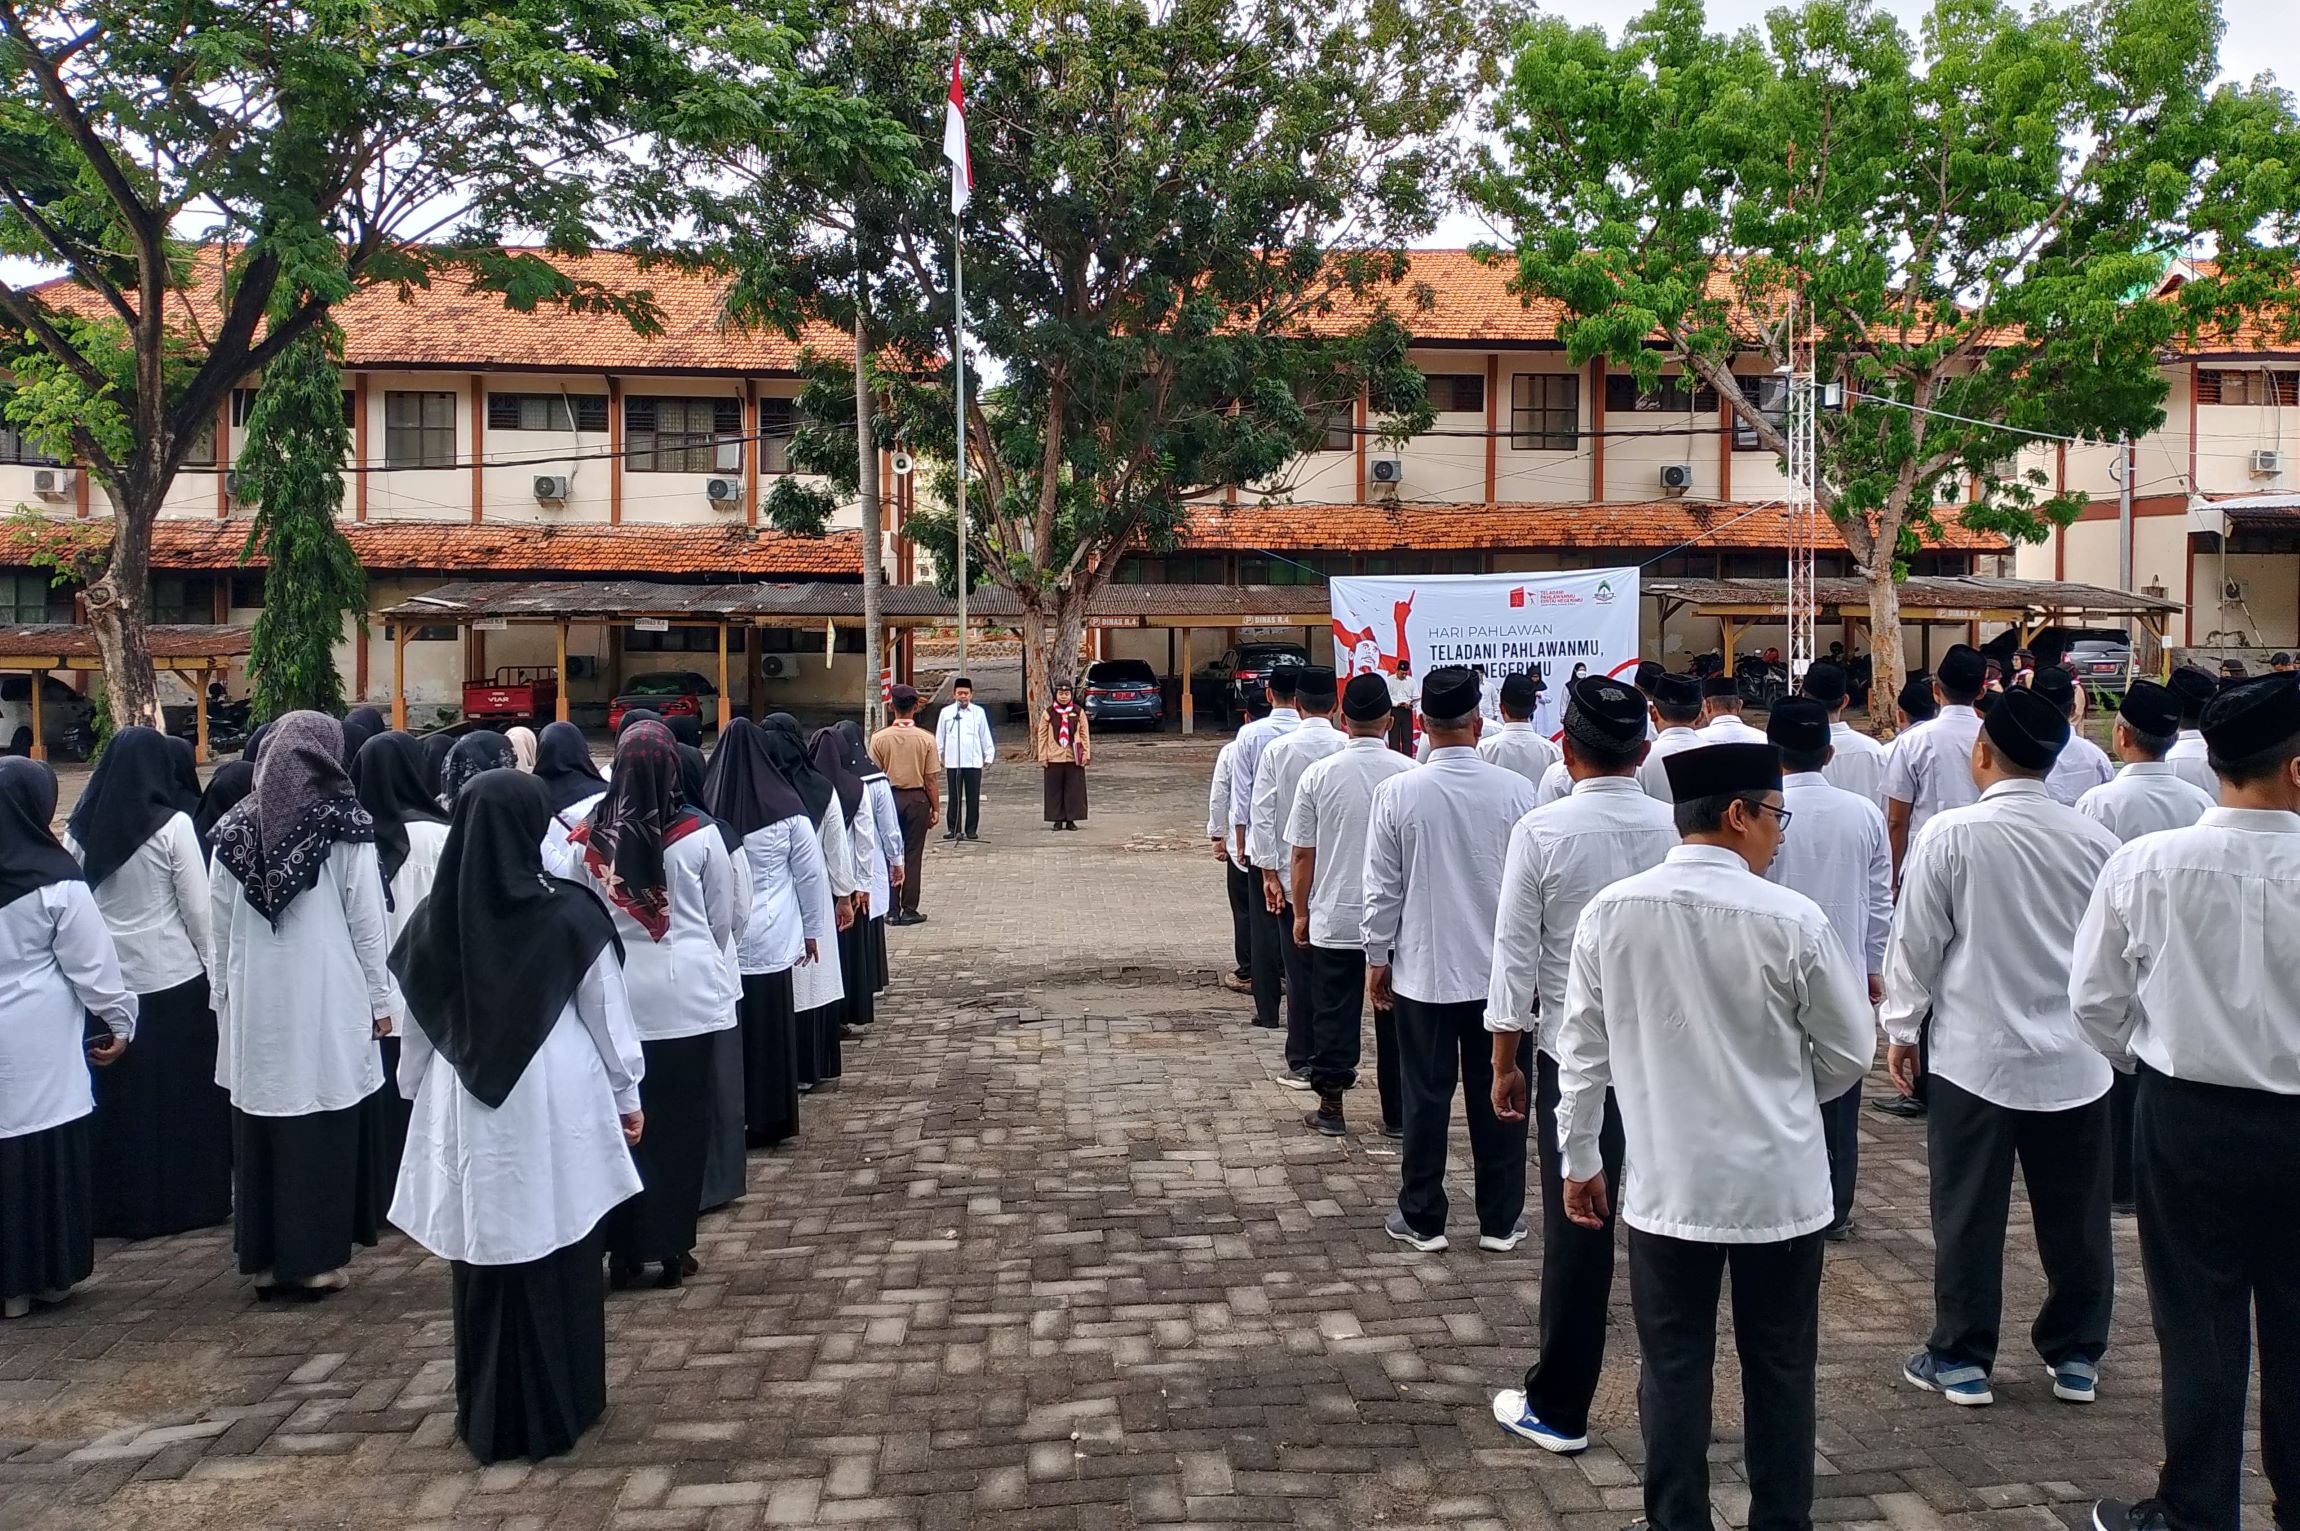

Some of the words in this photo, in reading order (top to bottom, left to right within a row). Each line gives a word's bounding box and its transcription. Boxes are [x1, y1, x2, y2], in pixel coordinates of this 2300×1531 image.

[1255, 616, 1275, 624] DINAS
[1429, 626, 1463, 638] HARI
[1468, 624, 1553, 638] PAHLAWAN
[1429, 643, 1497, 661] TELADANI
[1502, 640, 1604, 659] PAHLAWANMU,
[1484, 661, 1551, 678] NEGERIU
